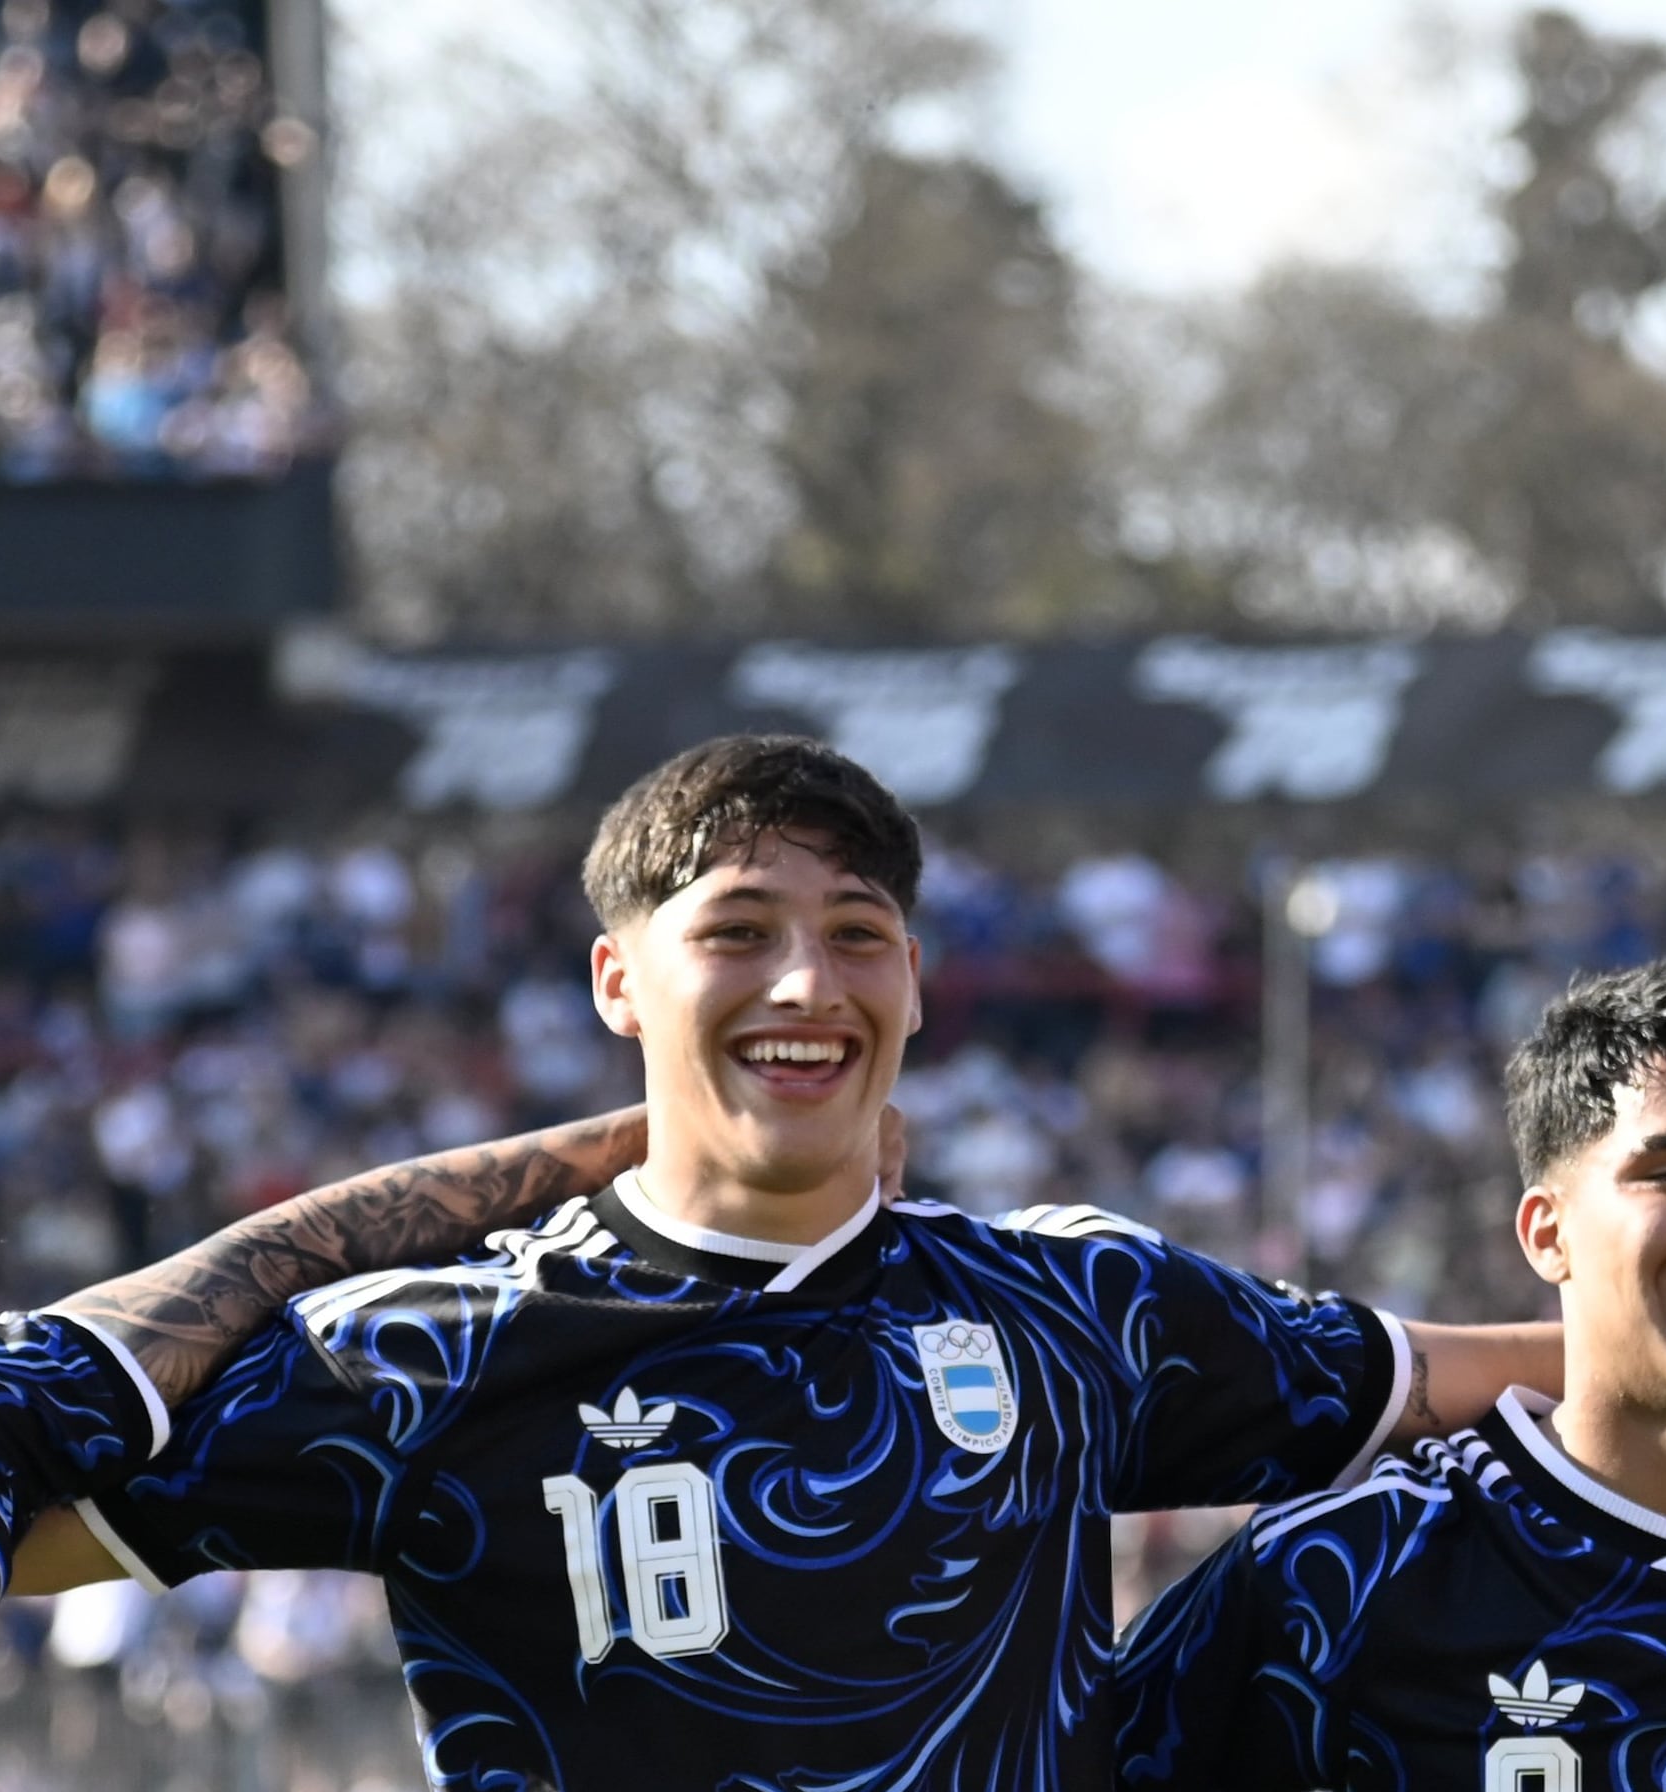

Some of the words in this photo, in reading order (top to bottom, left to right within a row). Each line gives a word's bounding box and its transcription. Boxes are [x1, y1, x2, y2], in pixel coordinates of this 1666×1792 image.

[929, 1368, 947, 1413] COMITE
[943, 1419, 1002, 1447] OLIMPICO
[542, 1462, 731, 1665] 18
